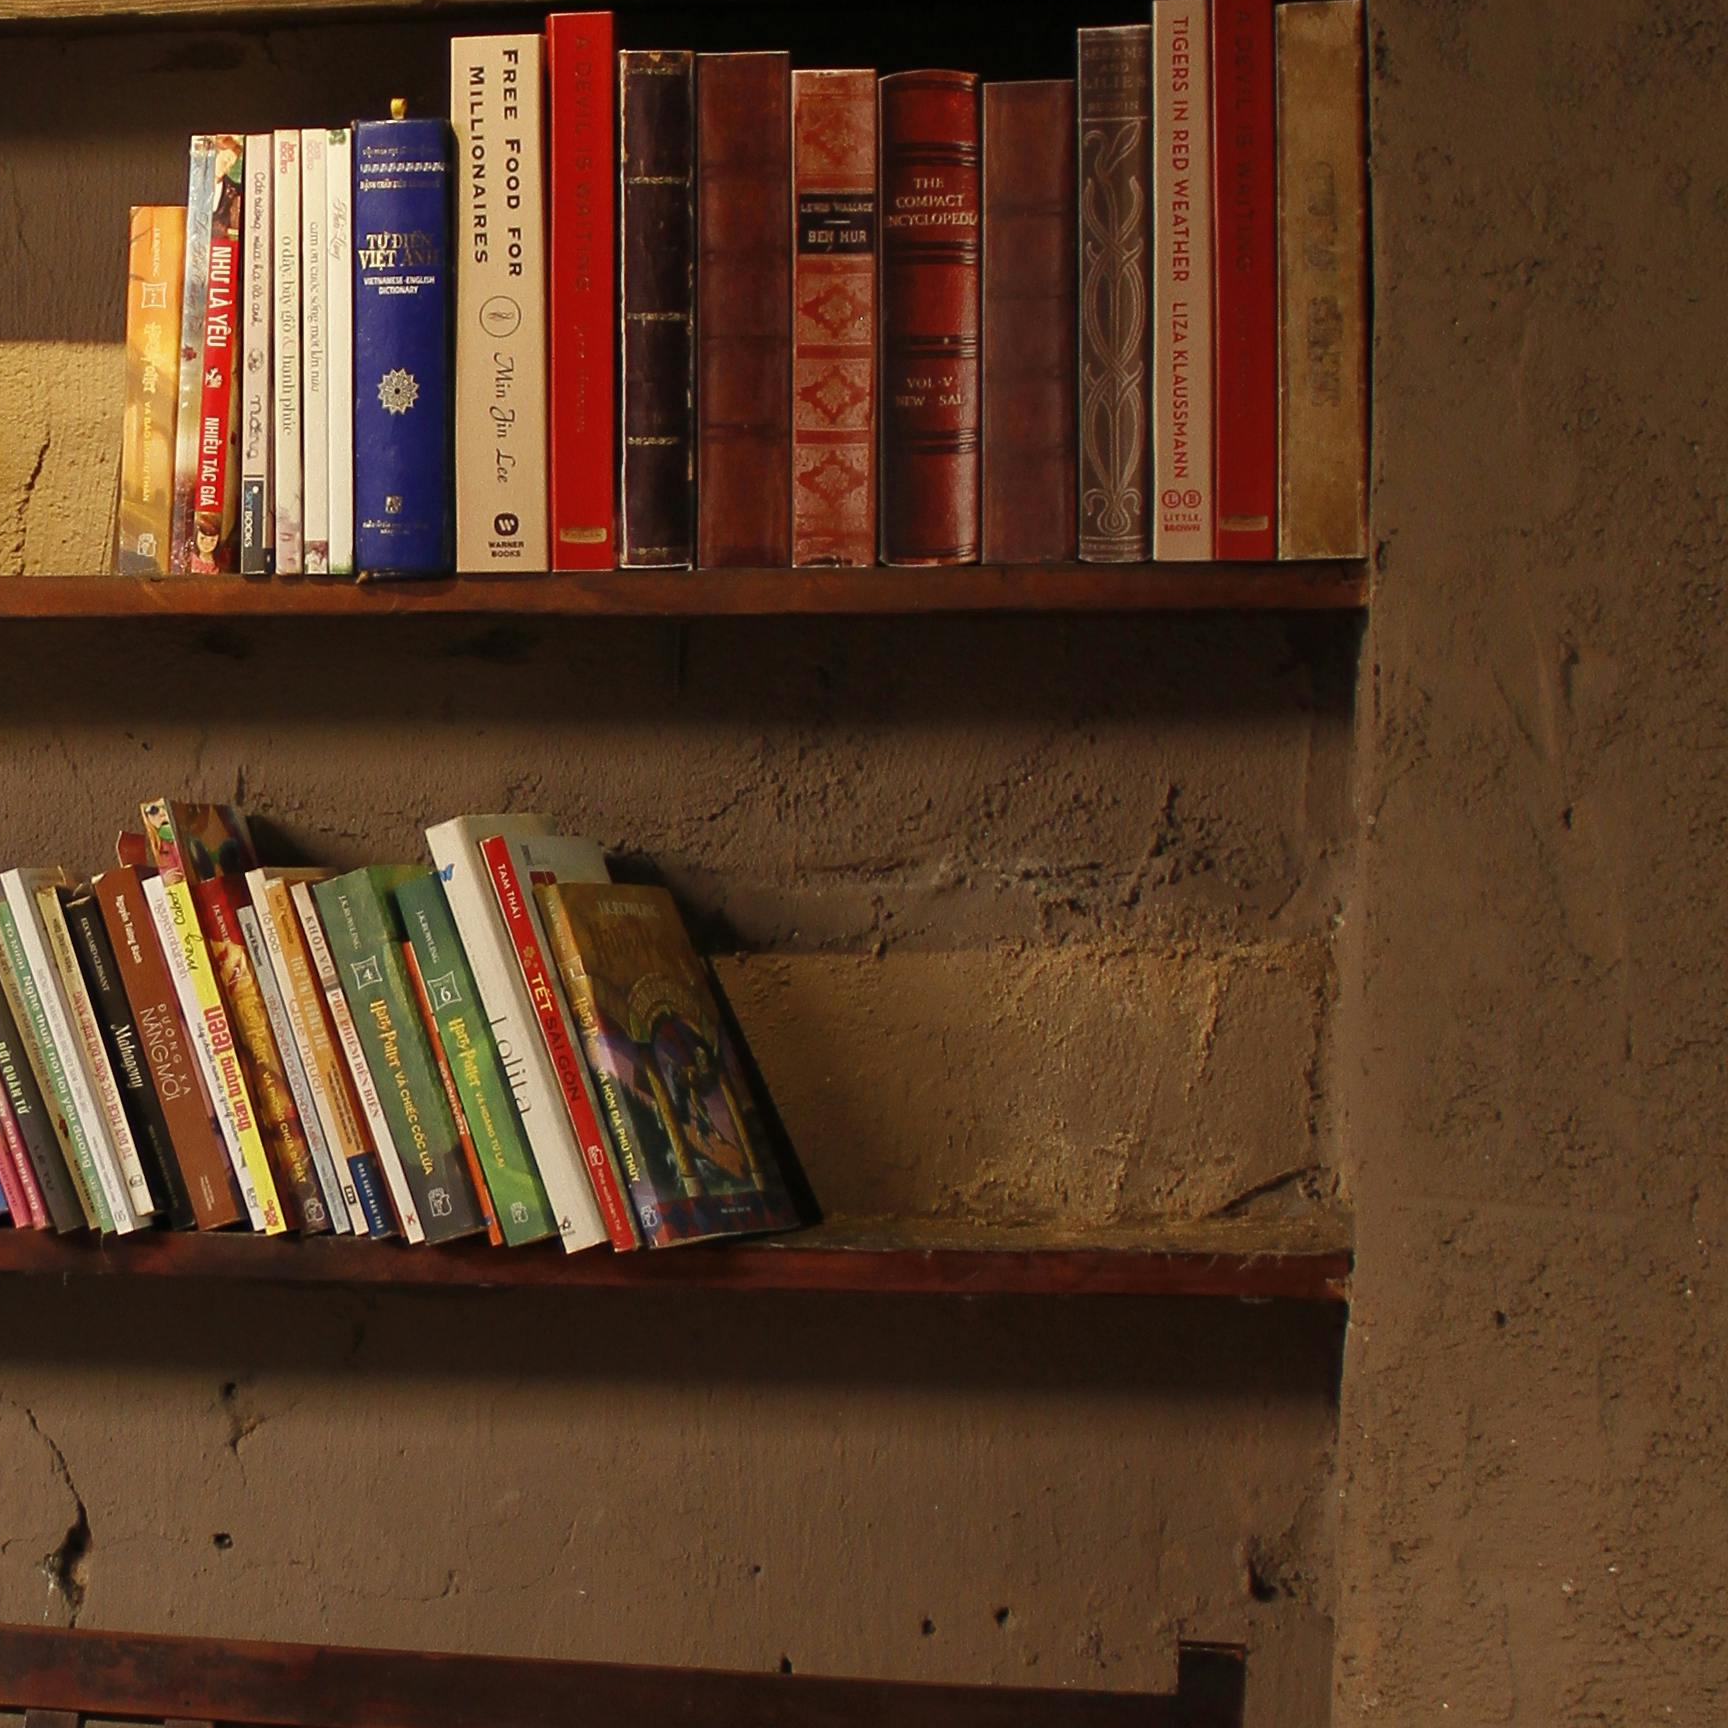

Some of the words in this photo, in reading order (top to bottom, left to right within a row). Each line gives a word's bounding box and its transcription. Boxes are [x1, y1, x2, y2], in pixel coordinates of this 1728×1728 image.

[1172, 17, 1190, 92] TIGERS
[503, 48, 519, 121] FREE
[576, 59, 592, 134] DEVIL
[1172, 98, 1190, 122] IN
[470, 66, 488, 265] MILLIONAIRES
[576, 148, 592, 172] IS
[1172, 129, 1190, 172] RED
[505, 138, 521, 210] FOOD
[913, 177, 945, 189] THE
[896, 194, 965, 208] COMPACT
[575, 180, 592, 293] WAITING
[808, 230, 833, 244] BEN
[840, 230, 867, 243] HUR
[1172, 179, 1190, 282] WEATHER
[210, 245, 232, 284] NHƯ
[507, 226, 522, 277] FOR
[209, 286, 233, 309] LÀ
[378, 285, 419, 295] DICTIONARY
[206, 313, 231, 348] YÊU
[1172, 301, 1190, 344] LIZA
[493, 351, 515, 399] Min
[489, 405, 516, 438] Jin
[1172, 350, 1190, 479] KLAUSSMANN
[201, 458, 221, 482] TÁC
[496, 447, 517, 484] Lee
[491, 550, 521, 558] BOOKS
[167, 889, 186, 926] Cabot
[506, 891, 521, 920] THÁI
[360, 966, 373, 981] 4
[439, 988, 452, 1003] 6
[531, 974, 553, 1012] TẾT
[203, 1006, 233, 1056] teen
[369, 999, 390, 1036] Harry
[377, 1026, 401, 1069] Potter
[448, 1017, 470, 1056] Harry
[395, 1070, 407, 1086] VÀ
[457, 1047, 480, 1087] Potter
[490, 1015, 533, 1116] Lolita
[60, 1089, 74, 1115] yêu
[410, 1120, 423, 1150] CỐC
